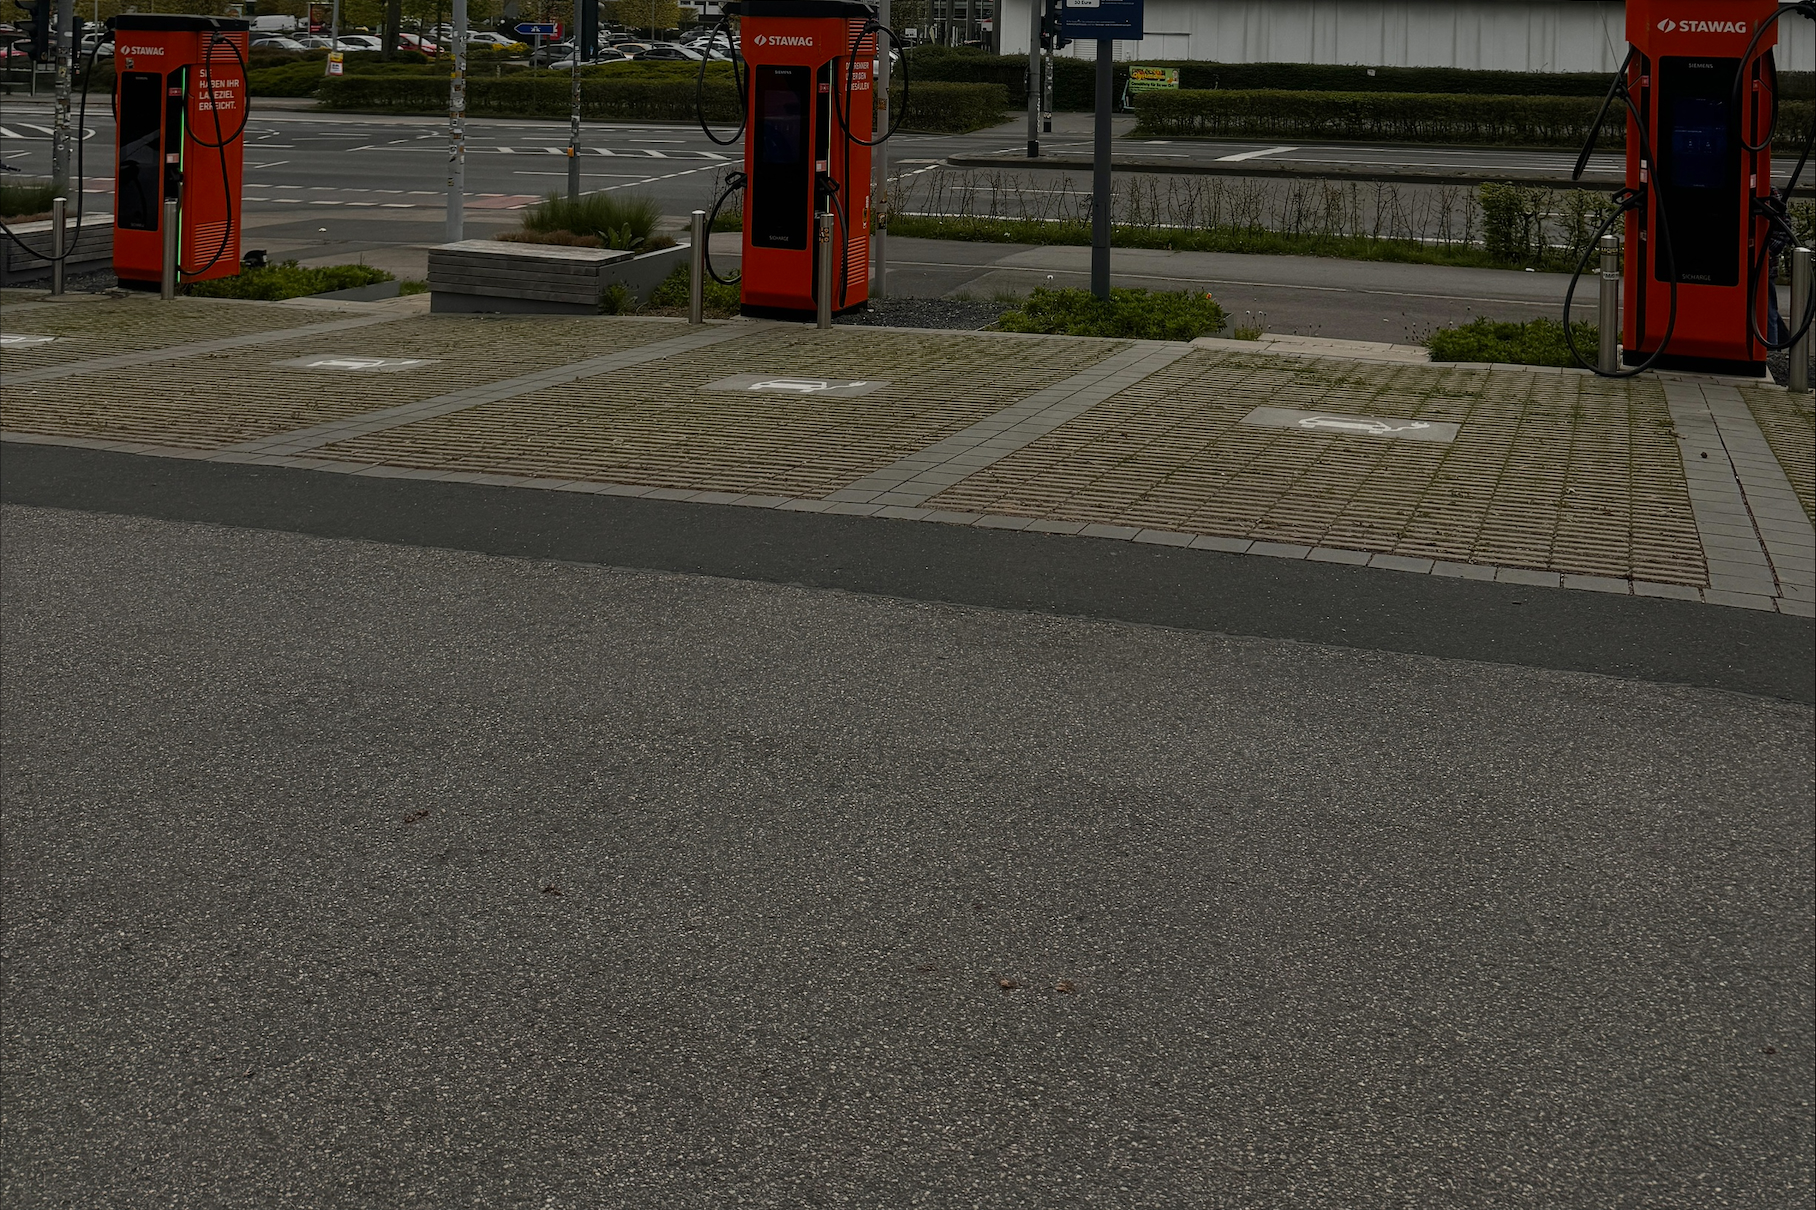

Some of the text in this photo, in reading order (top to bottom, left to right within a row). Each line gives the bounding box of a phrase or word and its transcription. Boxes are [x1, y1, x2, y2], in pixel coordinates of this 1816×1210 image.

[1679, 20, 1747, 34] STAWAG
[768, 36, 814, 47] STAWAG
[131, 46, 165, 56] STAWAG
[226, 79, 240, 88] IHR
[199, 90, 235, 100] LAEZIEL
[1682, 273, 1712, 282] SICHARGE
